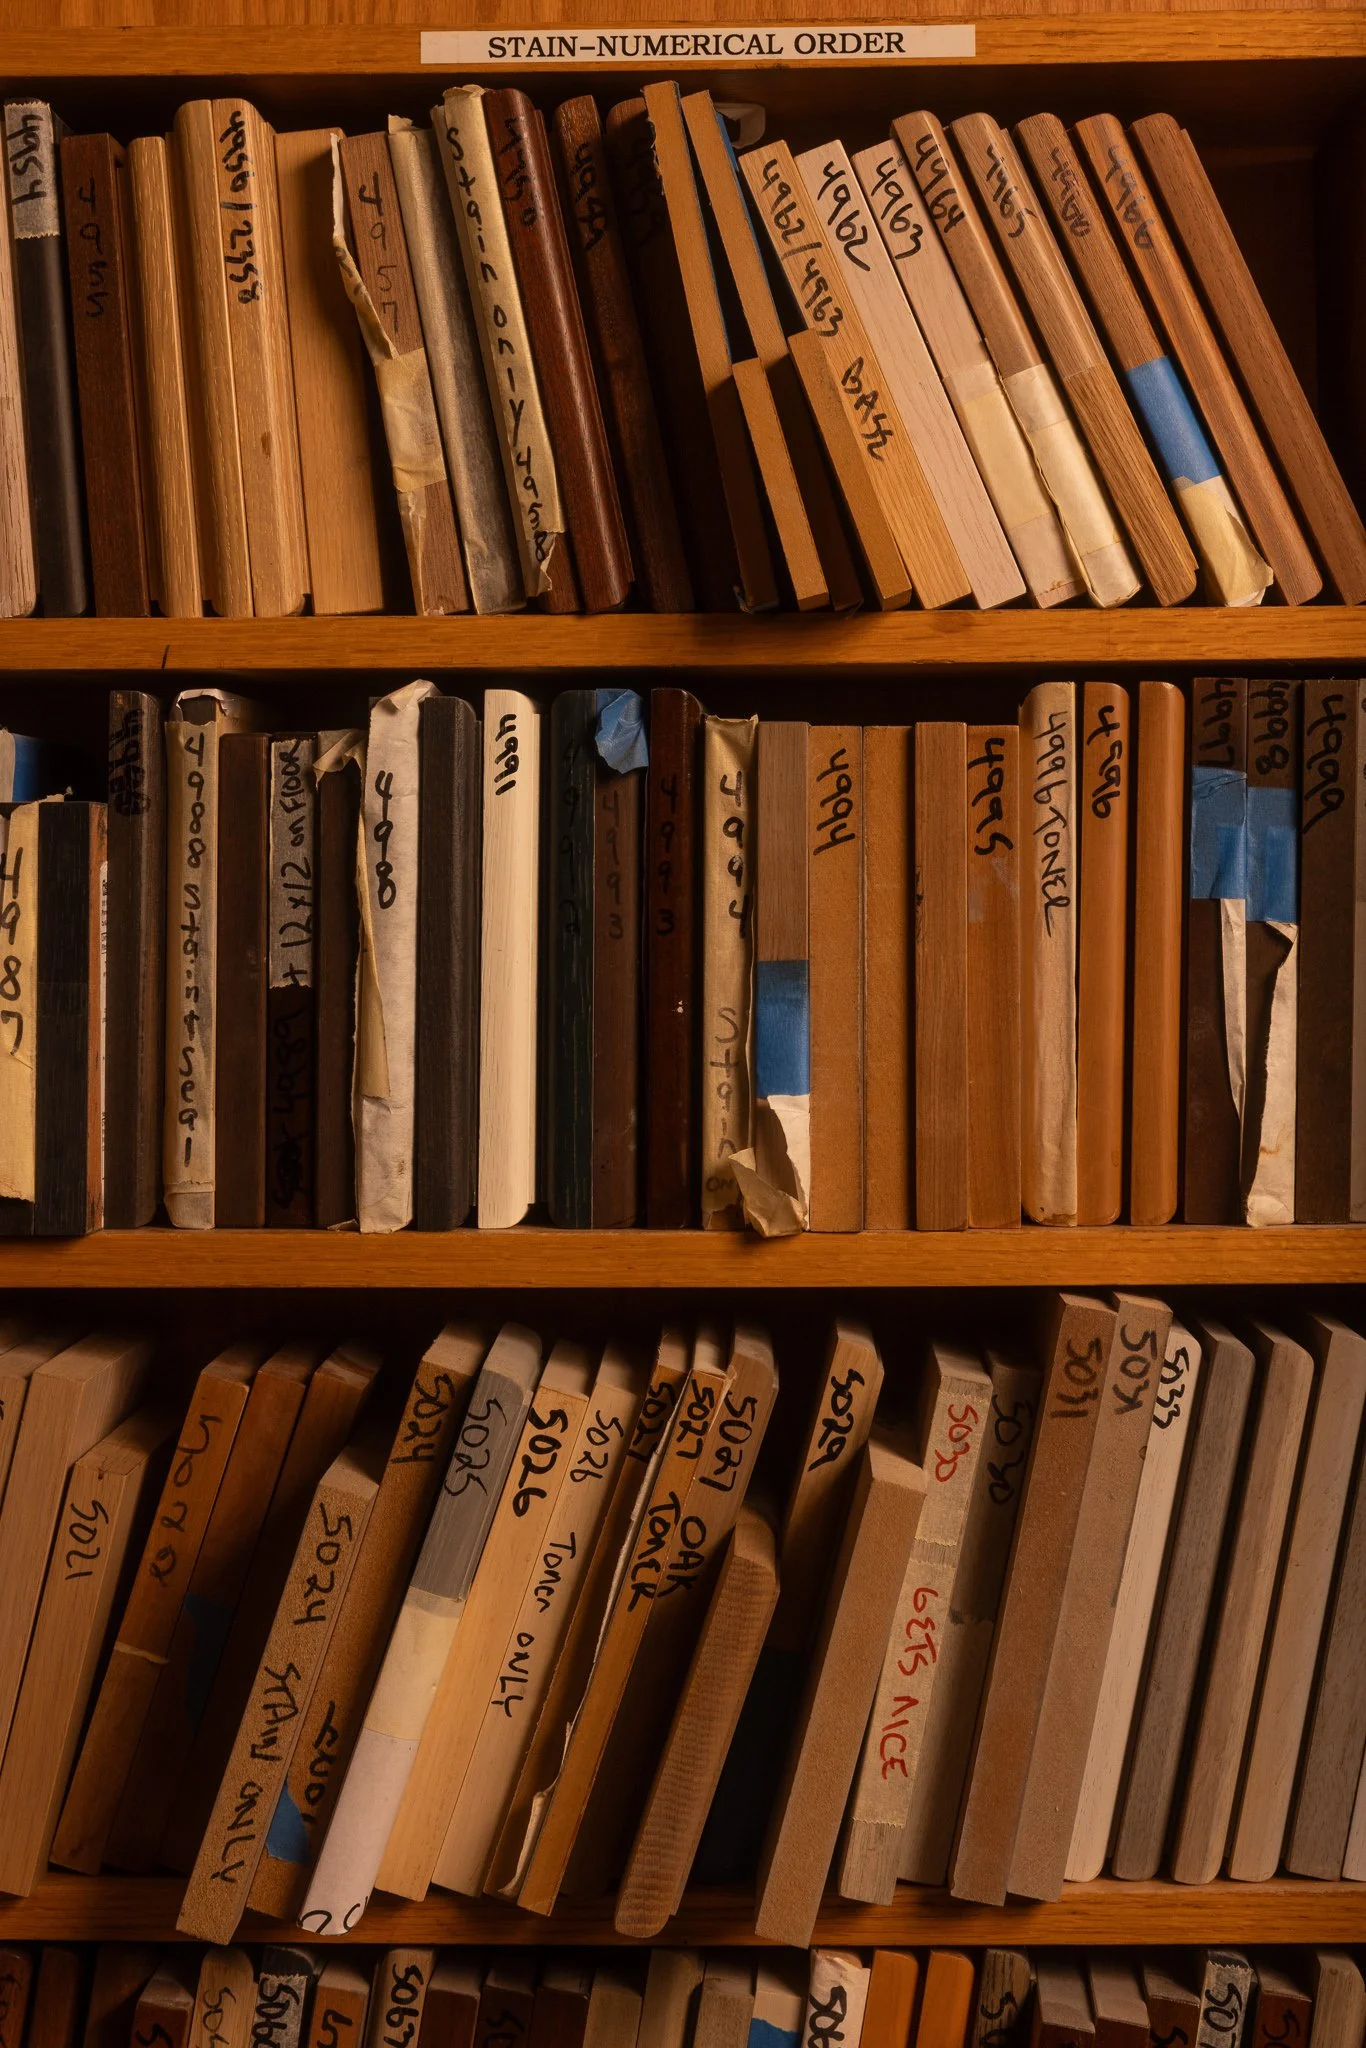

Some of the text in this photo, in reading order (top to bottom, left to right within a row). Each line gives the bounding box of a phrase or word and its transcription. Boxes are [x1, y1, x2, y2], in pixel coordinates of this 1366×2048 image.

[488, 32, 906, 59] STAIN-NUMERICAL ORDER
[7, 114, 47, 205] 4954
[871, 156, 924, 260] 4963
[916, 133, 965, 234] 4964
[358, 171, 398, 334] 4957
[816, 160, 871, 272] 4962
[446, 127, 498, 283] Stain
[493, 304, 525, 448] only
[495, 713, 520, 796] 4991
[1249, 682, 1290, 775] 4998
[1302, 693, 1348, 835] 4999
[184, 732, 207, 869] 4988
[812, 748, 856, 856] 4994
[966, 737, 1014, 856] 4995
[656, 773, 679, 937] 4993
[719, 770, 750, 940] 4994
[390, 1373, 456, 1464] 5024
[675, 1378, 715, 1460] 5027
[807, 1367, 865, 1472] 5029
[1051, 1336, 1102, 1420] 5031
[1151, 1346, 1191, 1430] 5033
[443, 1398, 508, 1497] 5025
[512, 1407, 569, 1518] 5026
[569, 1409, 624, 1483] 5026
[656, 1389, 758, 1599] 5027 OAK
[65, 1499, 109, 1581] 5021
[293, 1502, 353, 1626] 5024
[879, 1403, 979, 1781] 5030 GETS NICE
